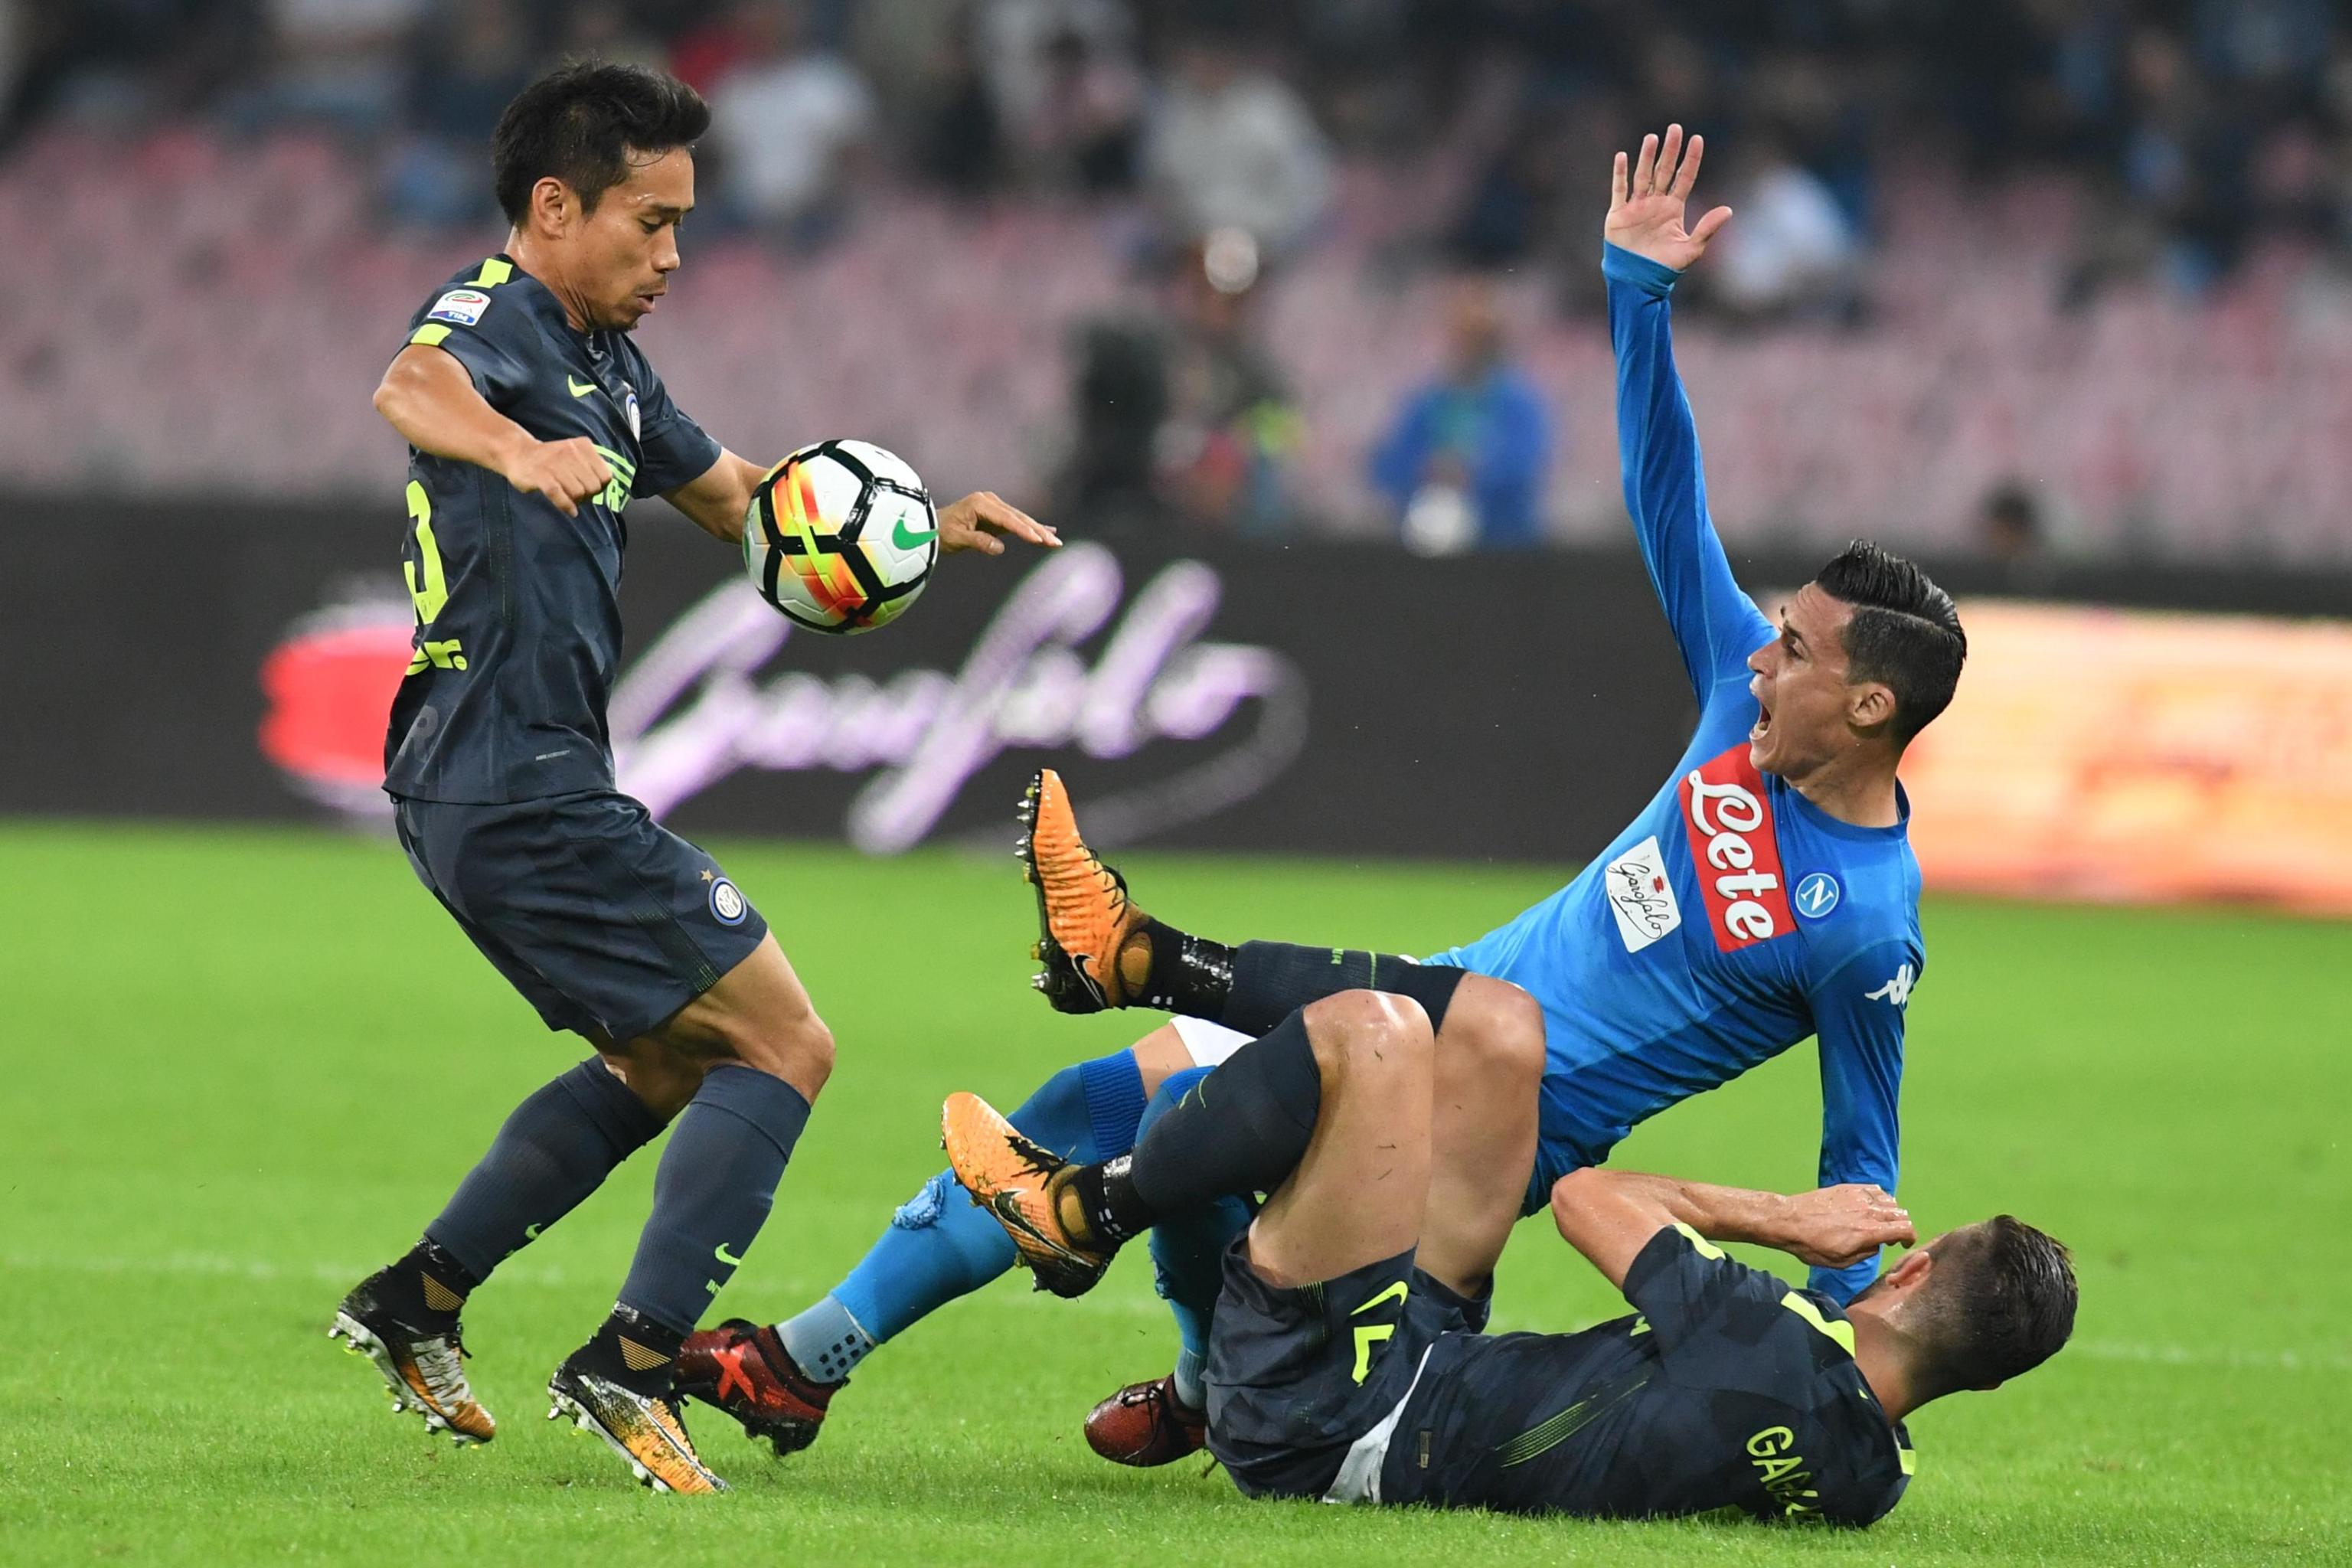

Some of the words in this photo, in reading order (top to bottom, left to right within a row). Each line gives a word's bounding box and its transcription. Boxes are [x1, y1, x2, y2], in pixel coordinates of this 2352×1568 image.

[448, 311, 469, 321] TIM
[1688, 769, 1778, 940] Lete
[1607, 862, 1670, 940] Garofalo
